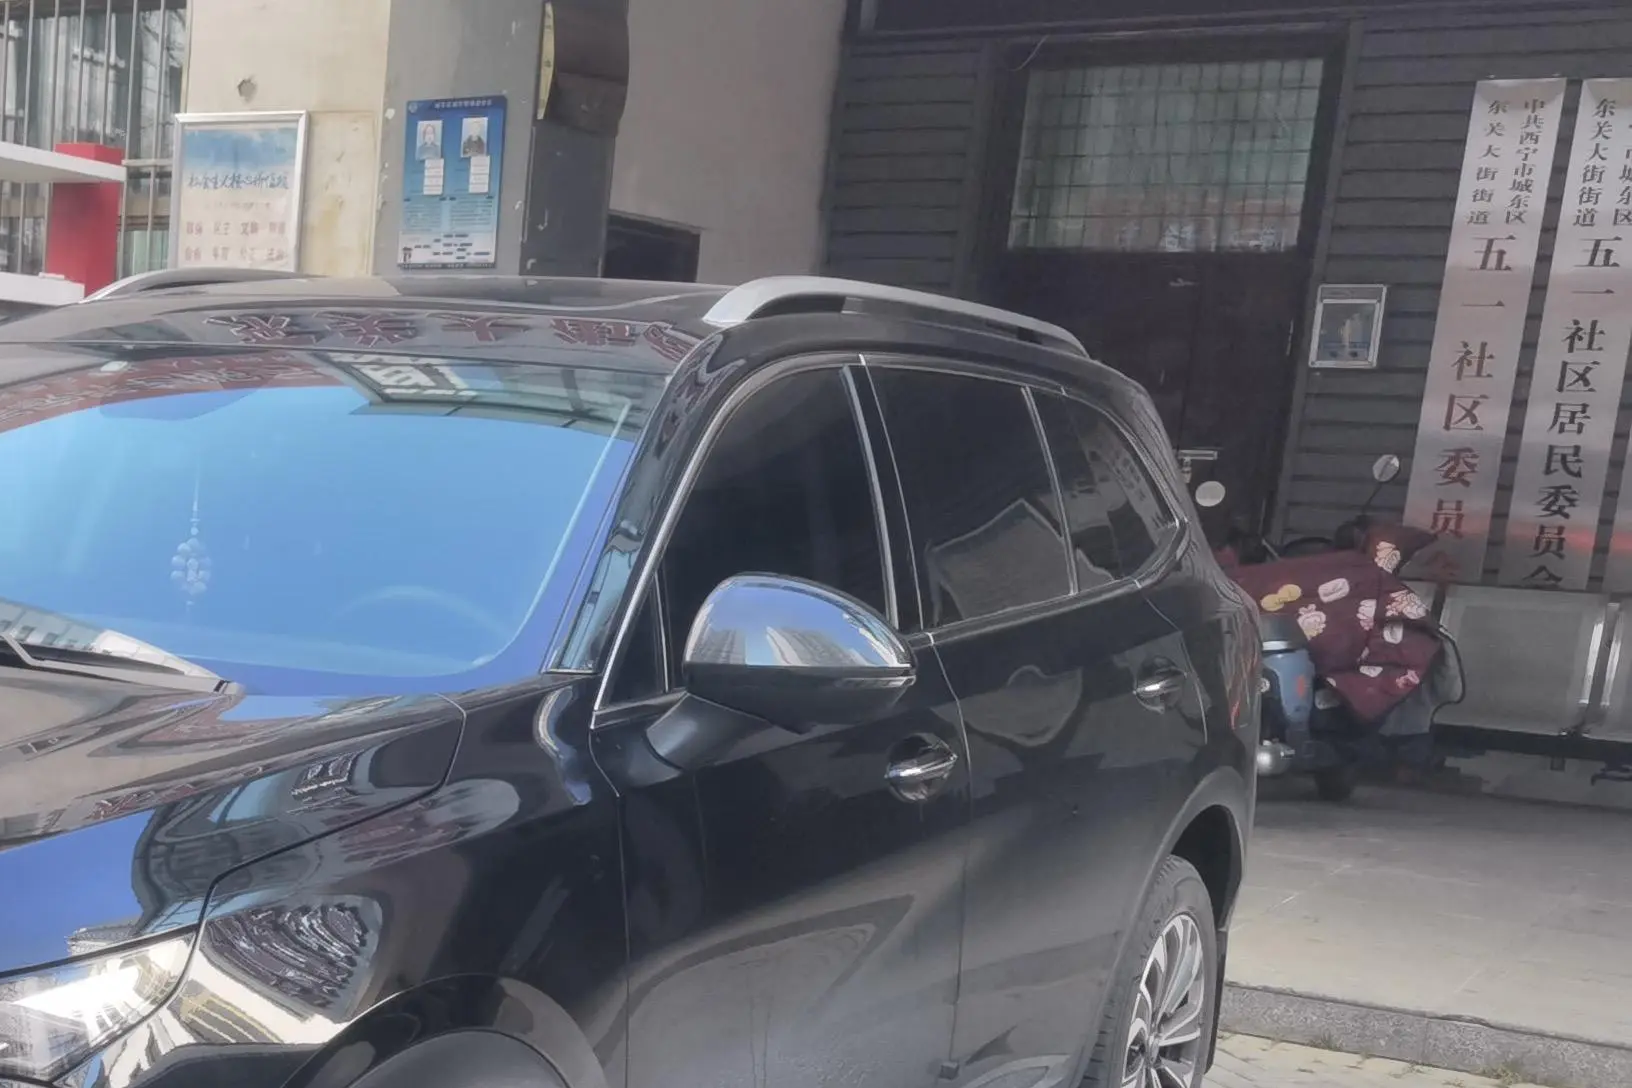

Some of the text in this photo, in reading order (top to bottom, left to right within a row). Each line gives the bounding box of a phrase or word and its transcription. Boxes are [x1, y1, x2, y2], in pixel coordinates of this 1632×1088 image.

[1467, 100, 1509, 225] 东关大街街道
[1505, 98, 1545, 224] 中共西宁市城东区
[1572, 98, 1616, 227] 东关大街街道
[1423, 234, 1517, 589] 五一社区委员会
[1522, 235, 1622, 589] 五一社区居民委员会
